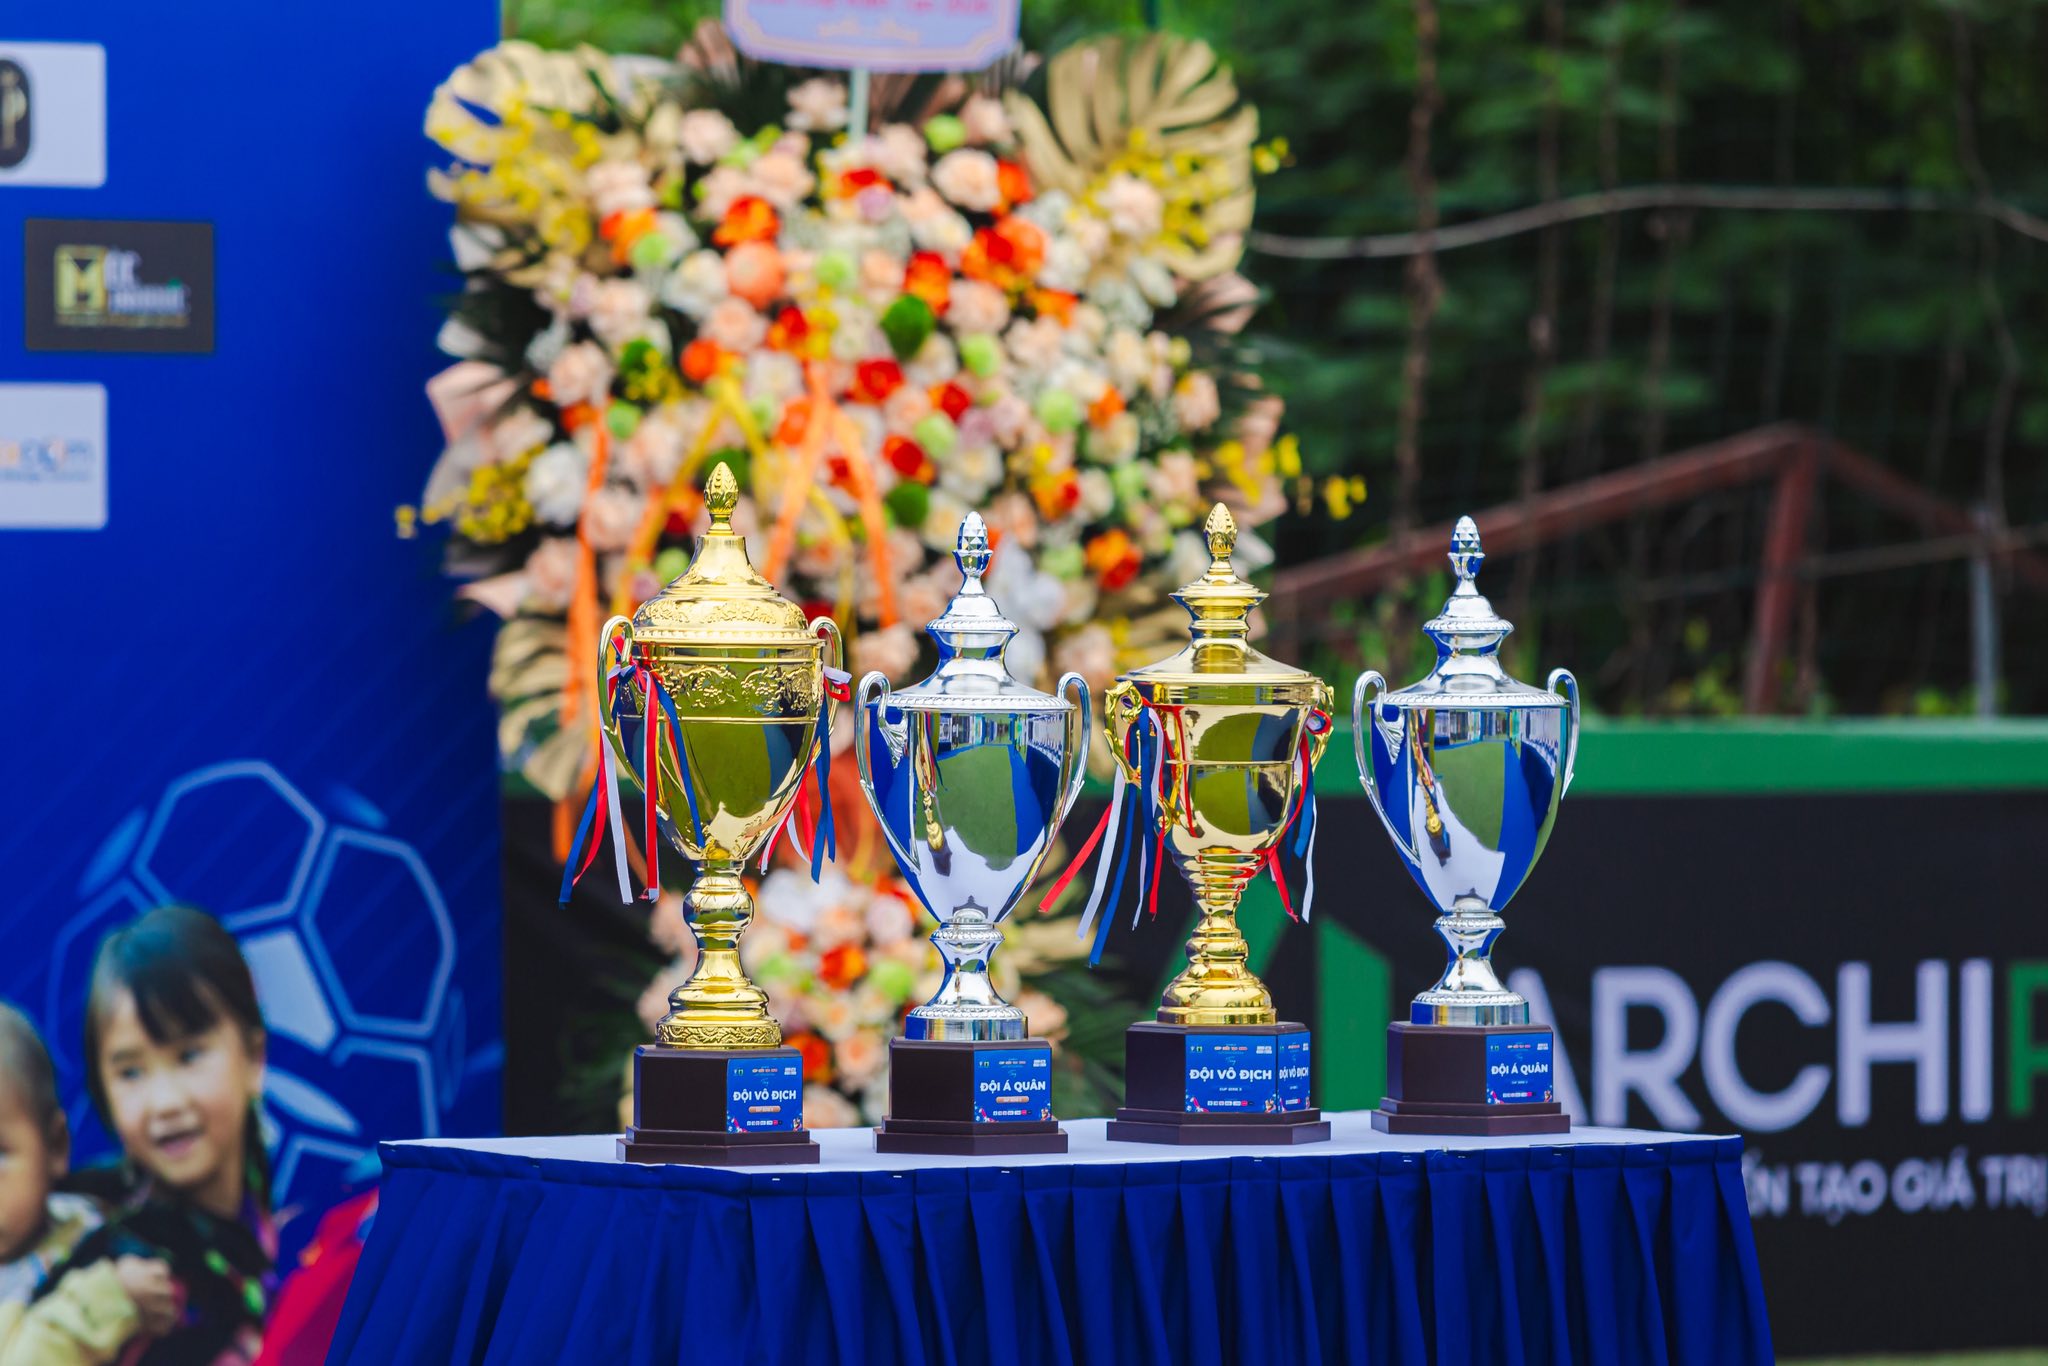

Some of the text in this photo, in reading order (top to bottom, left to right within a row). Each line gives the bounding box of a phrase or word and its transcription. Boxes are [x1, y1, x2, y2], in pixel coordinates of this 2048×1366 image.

[1189, 1066, 1272, 1082] ĐỘI VÔ ĐỊCH
[1491, 1062, 1548, 1077] ĐỘI Á QUÂN
[980, 1078, 1046, 1094] ĐỘI Á QUÂN
[733, 1088, 797, 1104] ĐỘI VÔ ĐỊCH
[1796, 1159, 1888, 1227] TẠO
[1891, 1145, 1975, 1214] GIÁ
